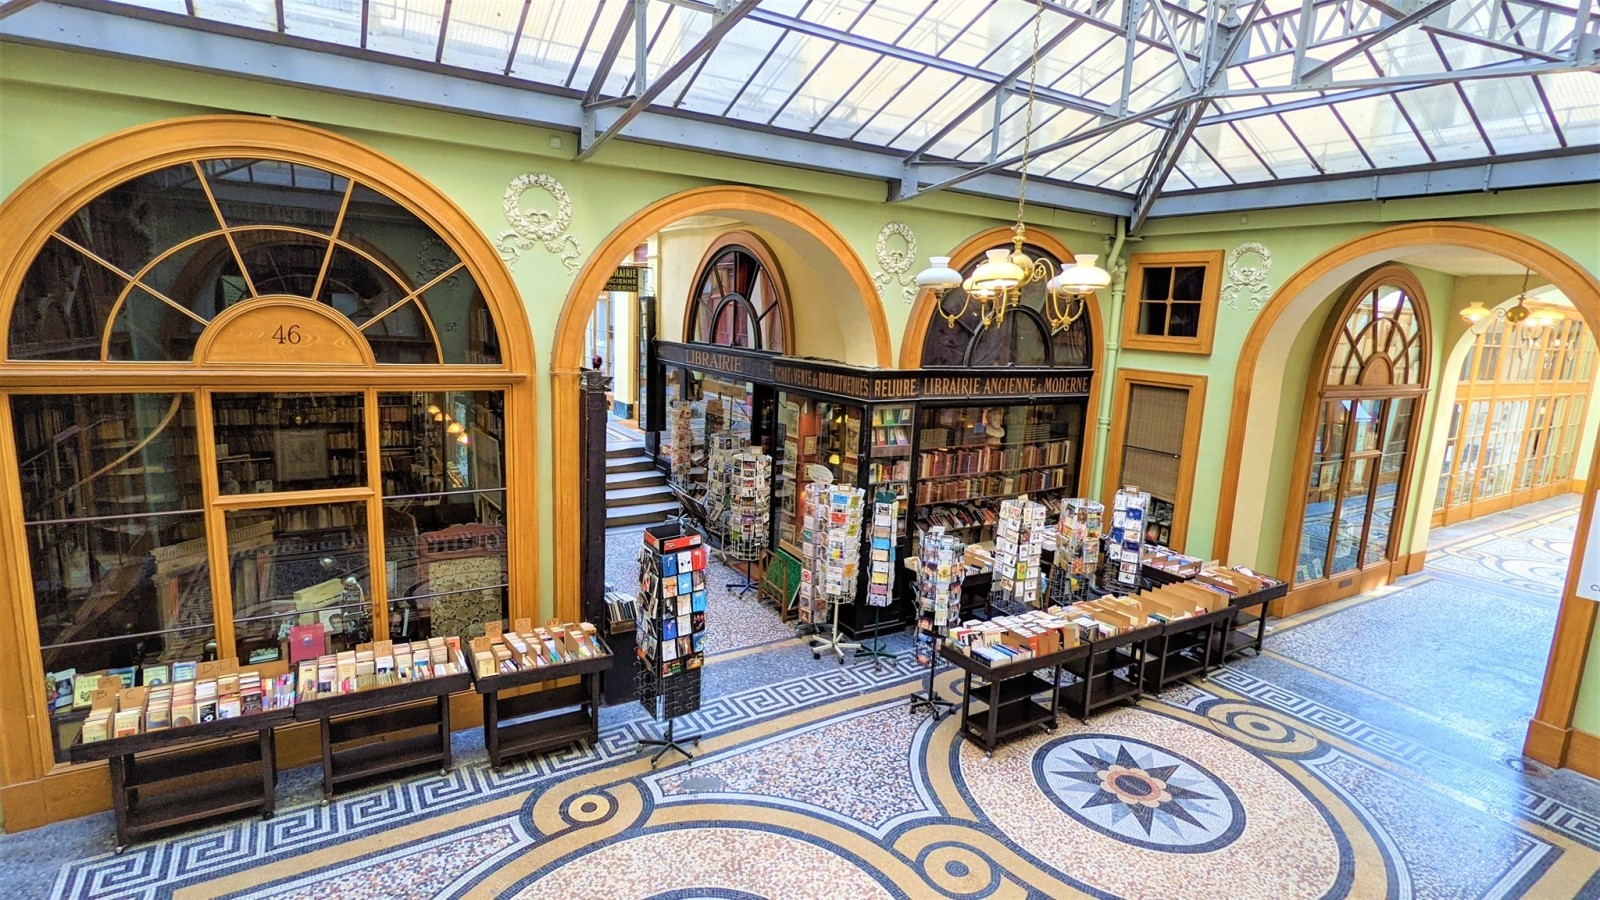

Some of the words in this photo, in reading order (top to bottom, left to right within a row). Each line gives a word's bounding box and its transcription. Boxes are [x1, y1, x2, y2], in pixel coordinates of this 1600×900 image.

[272, 324, 301, 345] 46
[685, 349, 742, 372] LIBRAIRIE
[794, 367, 812, 387] VENTE
[924, 378, 980, 395] LIBRAIRIE
[983, 377, 1036, 395] ANCIENNE
[1037, 383, 1042, 393] &
[1043, 376, 1088, 393] MODERNE
[874, 379, 916, 397] RELIURE
